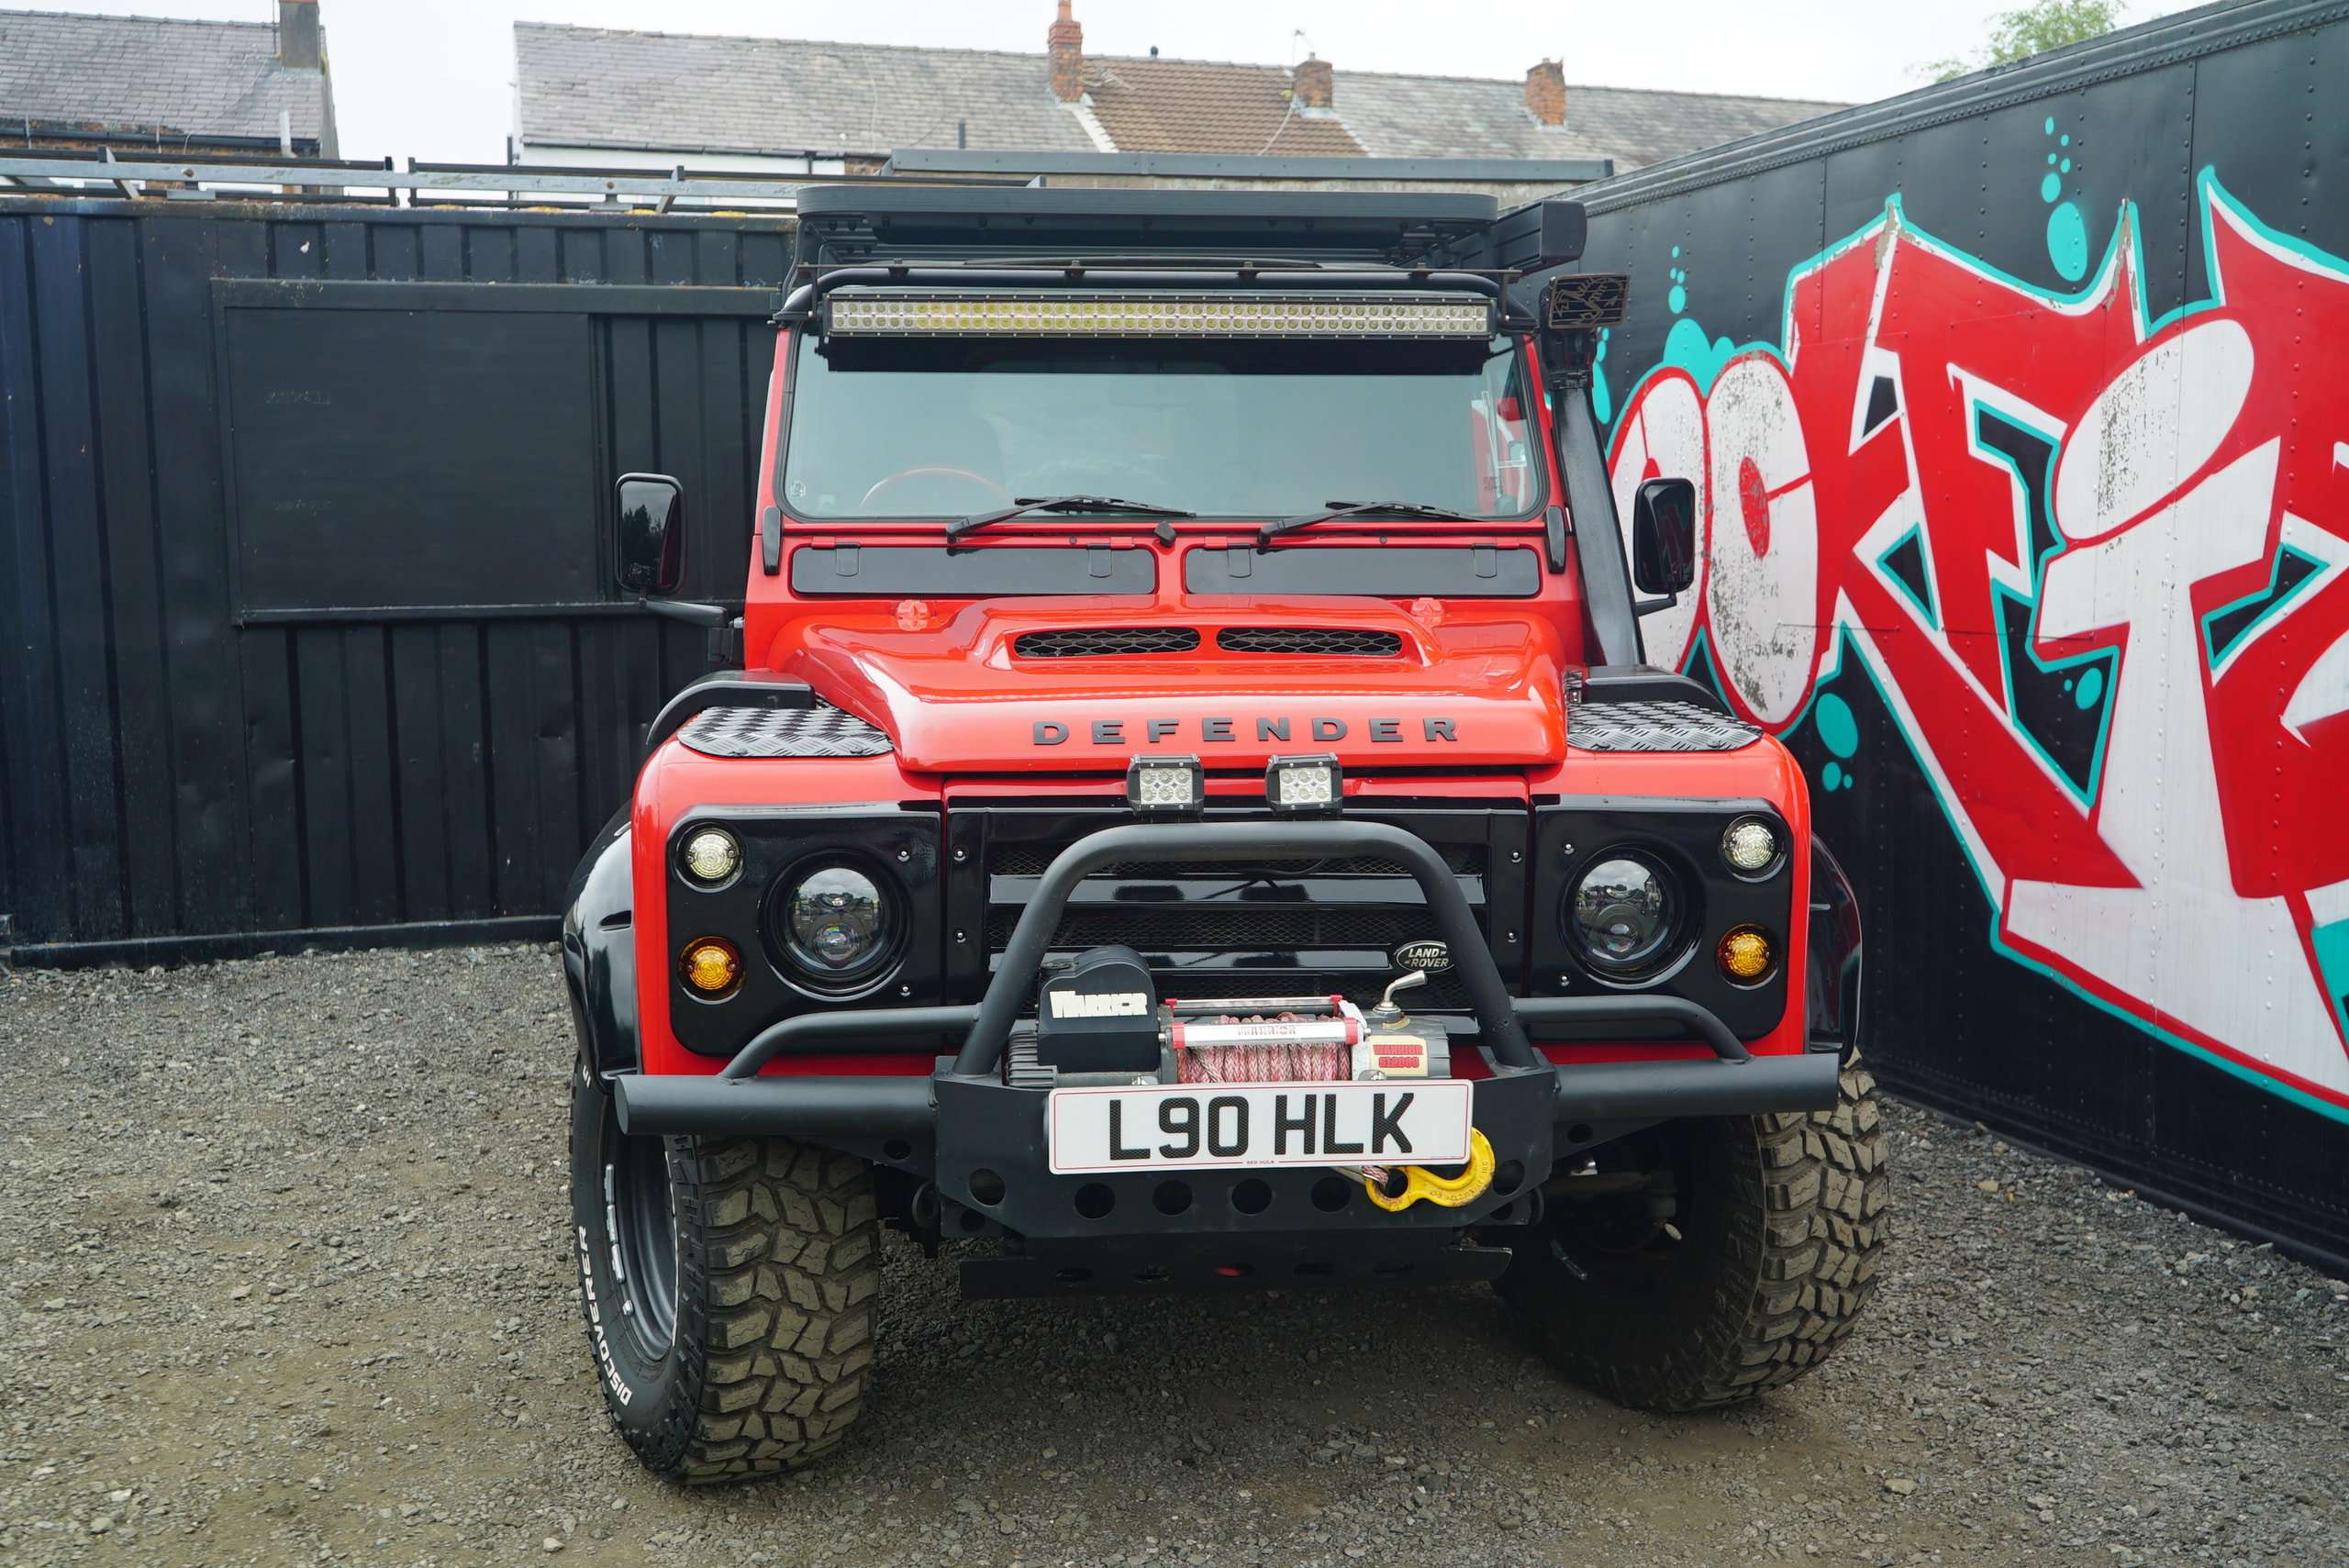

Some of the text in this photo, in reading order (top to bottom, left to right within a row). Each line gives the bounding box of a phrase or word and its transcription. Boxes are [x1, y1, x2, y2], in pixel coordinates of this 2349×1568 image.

[1032, 717, 1459, 745] DEFENDER
[1408, 948, 1440, 958] LAND
[1410, 958, 1449, 967] ROVER
[1108, 1092, 1416, 1162] L90 HLK
[578, 1225, 633, 1407] DISCOVERER
